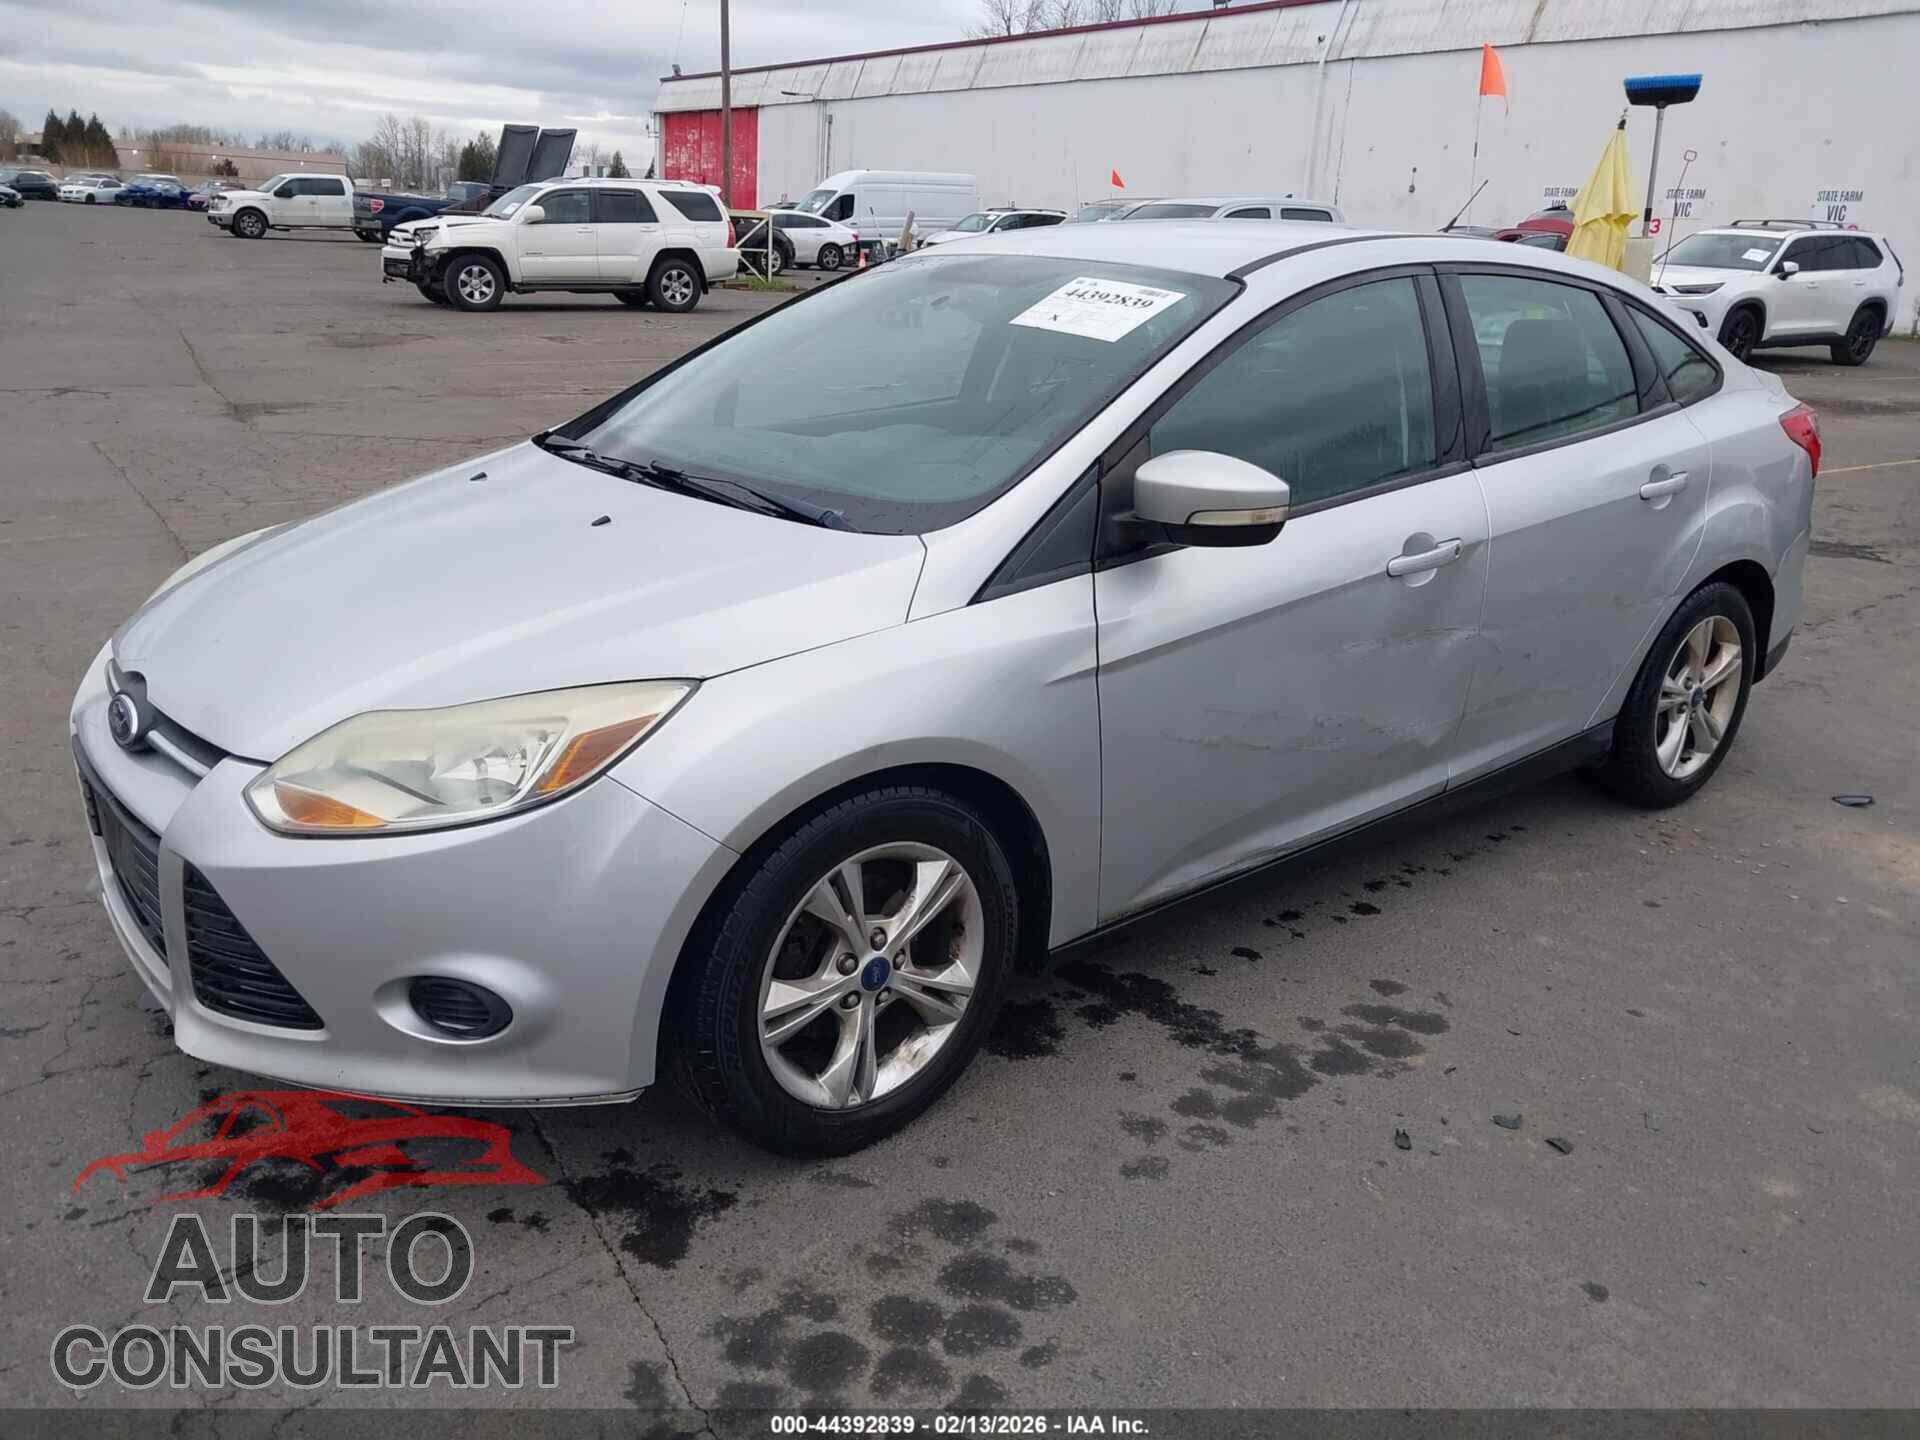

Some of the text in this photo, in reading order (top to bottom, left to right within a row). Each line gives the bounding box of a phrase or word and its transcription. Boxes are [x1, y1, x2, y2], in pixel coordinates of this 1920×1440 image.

[1544, 187, 1578, 197] STATE FARM
[1666, 189, 1706, 199] STATE FARM
[1817, 191, 1863, 201] STATE FARM
[1673, 202, 1692, 217] VIC
[1827, 205, 1847, 221] VIC
[1649, 218, 1661, 233] 3
[1066, 288, 1154, 309] 44392839
